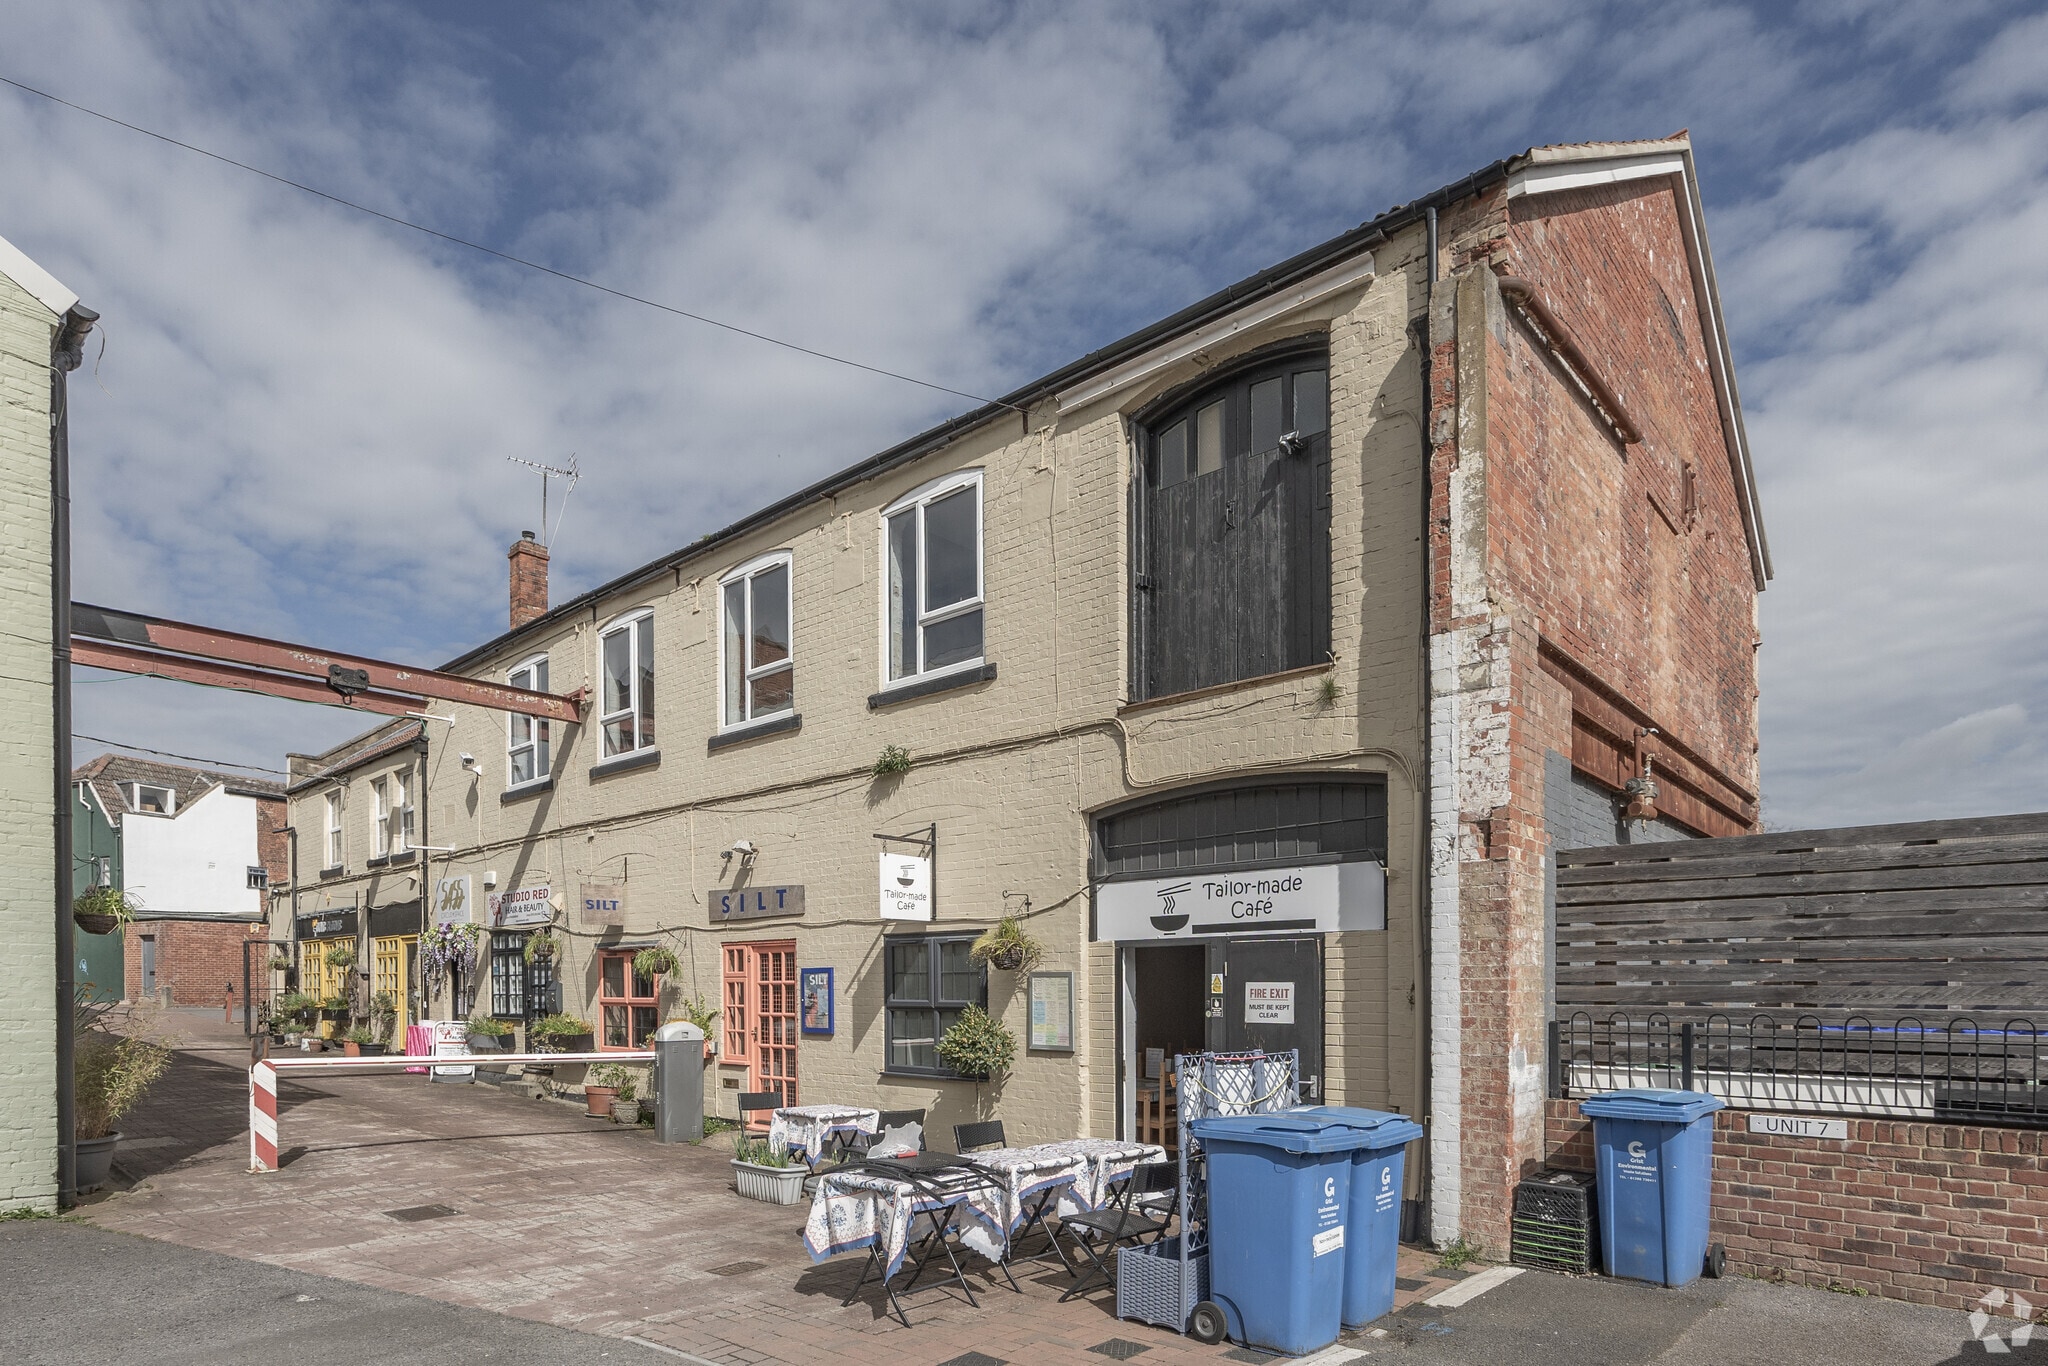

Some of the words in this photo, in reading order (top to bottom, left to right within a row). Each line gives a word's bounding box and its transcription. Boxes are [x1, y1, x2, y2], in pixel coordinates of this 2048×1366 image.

[884, 889, 927, 900] Tailor-made
[1202, 875, 1303, 900] Tailor-made
[502, 890, 530, 904] STUDIO
[533, 888, 549, 900] RED
[721, 889, 787, 913] SILT
[505, 905, 518, 914] HAIR
[523, 902, 545, 912] BEAUTY
[585, 899, 619, 910] SILT
[897, 900, 916, 910] Café
[1231, 896, 1273, 918] Café
[1249, 988, 1267, 998] FIRE
[1269, 988, 1290, 998] EXIT
[1766, 1118, 1812, 1134] UNIT
[1818, 1122, 1829, 1136] 7
